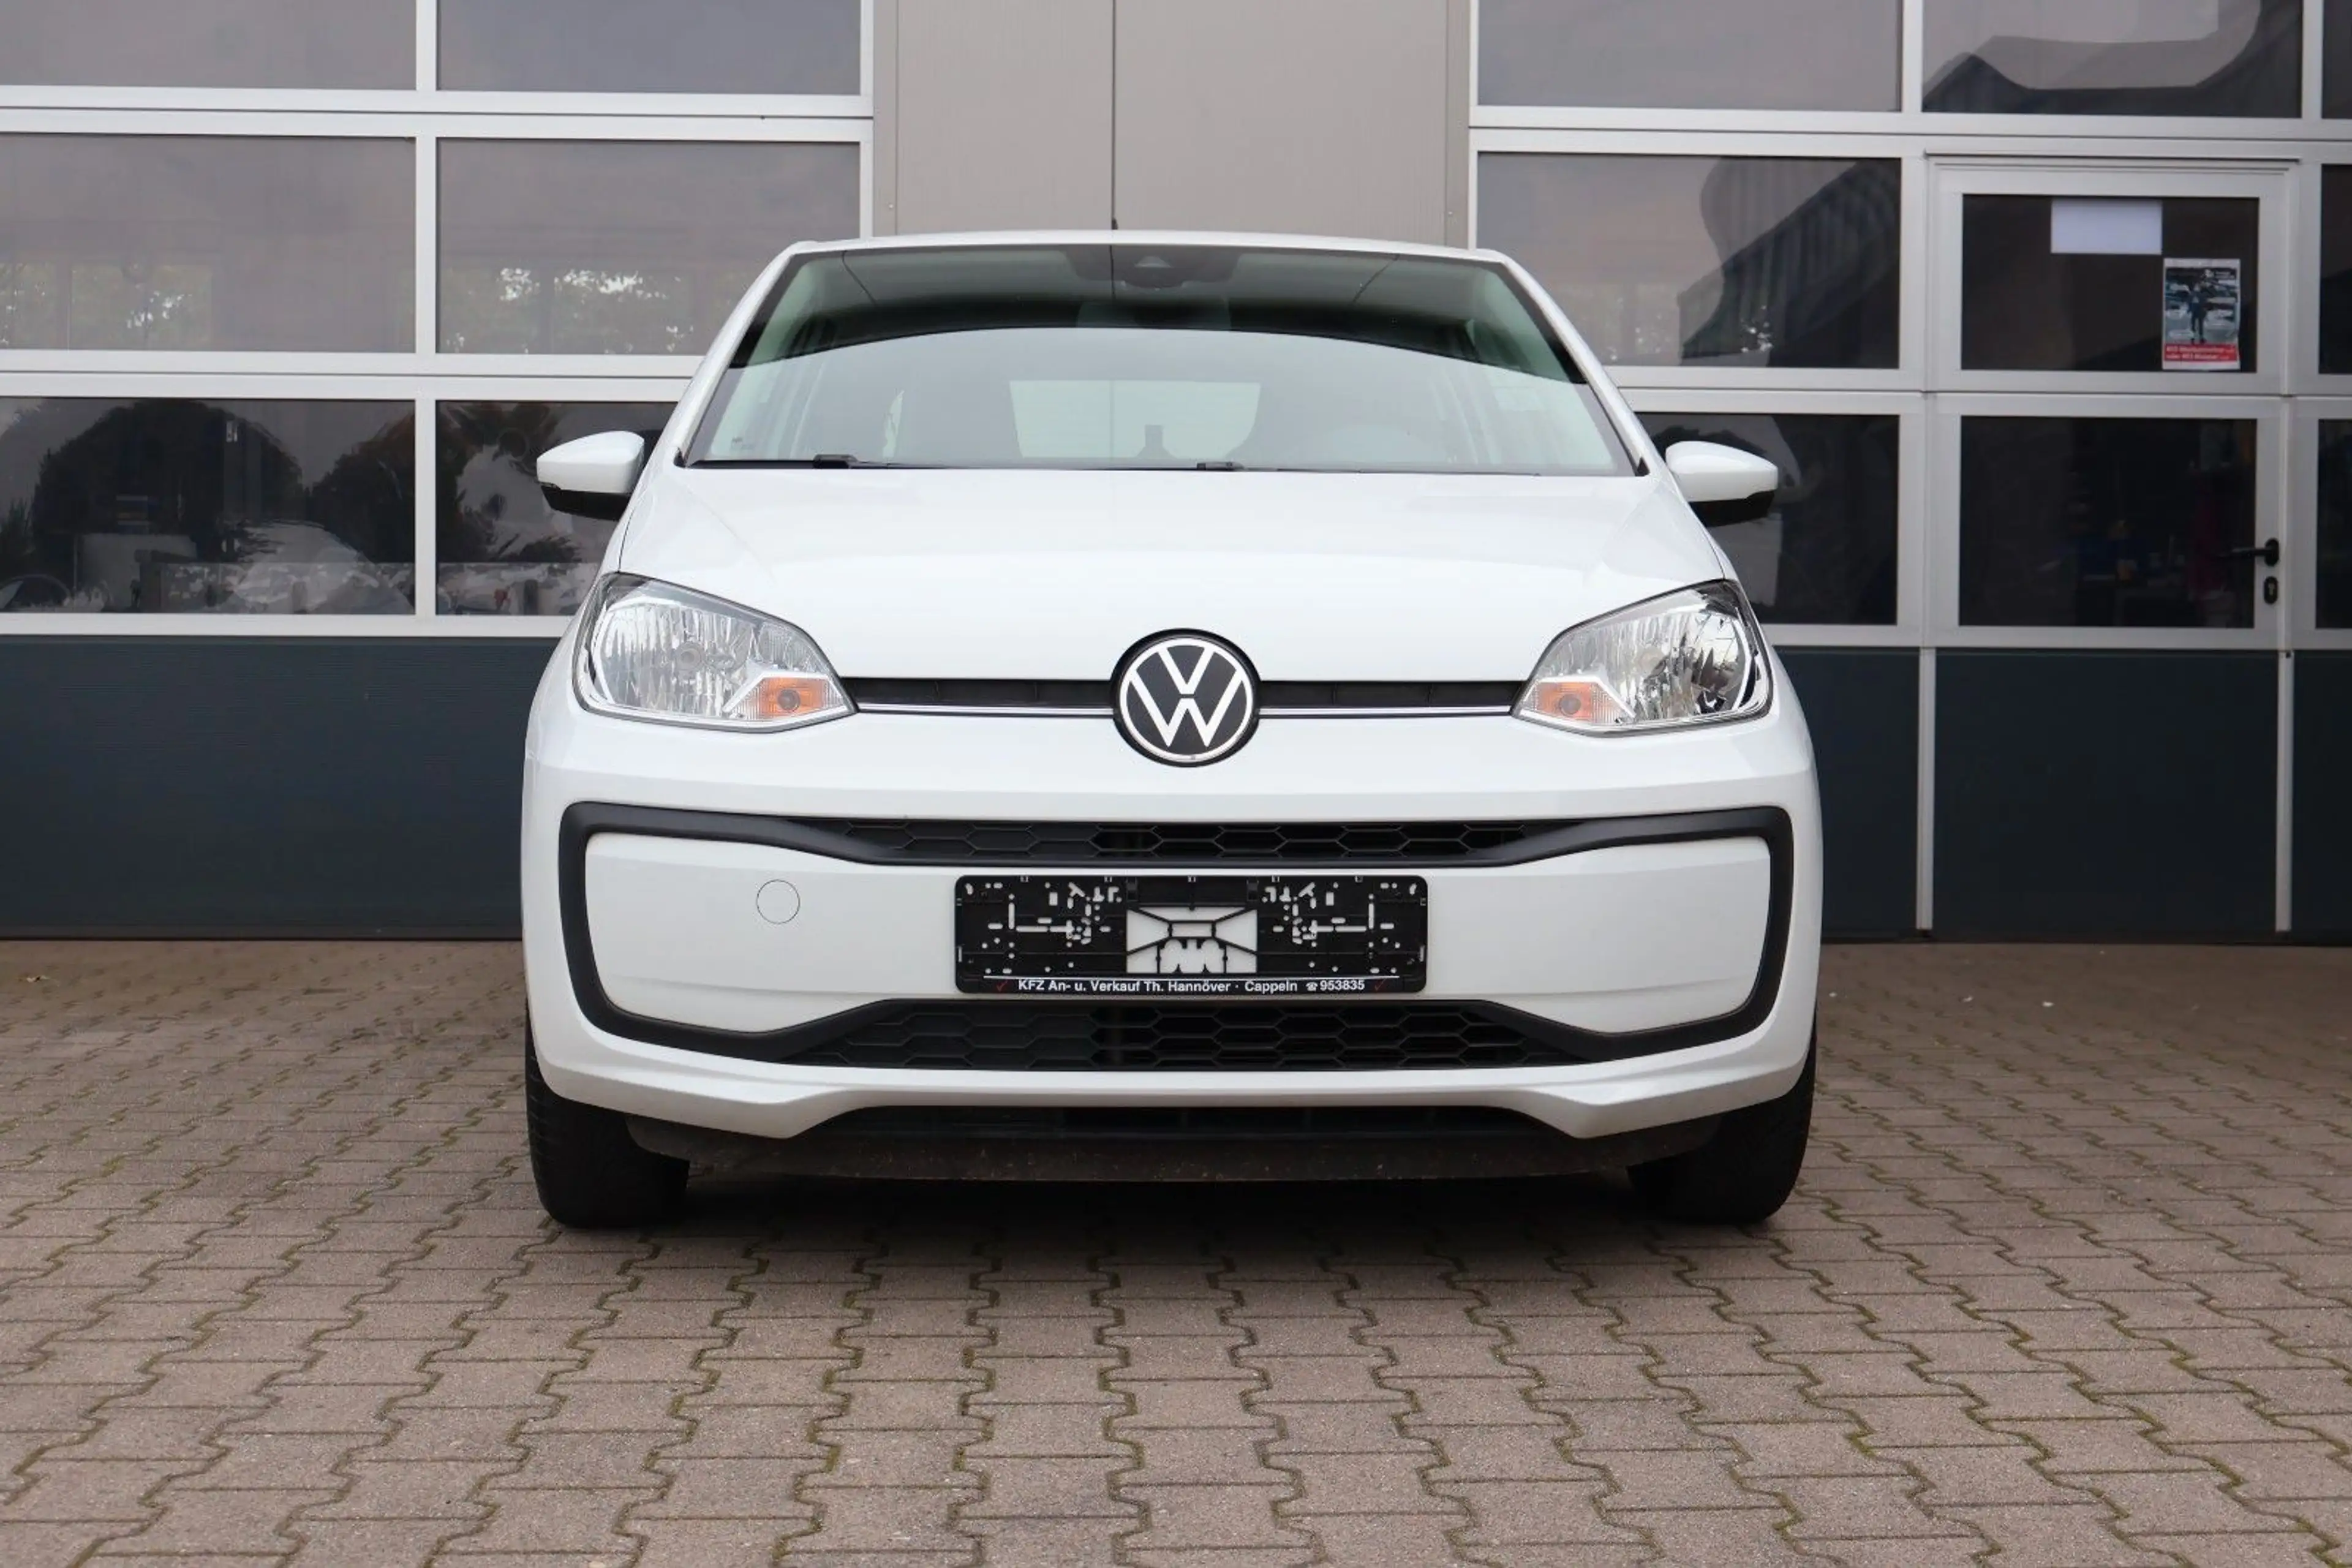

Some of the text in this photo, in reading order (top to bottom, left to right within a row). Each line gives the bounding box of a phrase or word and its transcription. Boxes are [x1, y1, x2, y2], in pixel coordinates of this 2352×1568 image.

[1127, 641, 1246, 748] VW
[1018, 979, 1045, 990] KFZ
[1048, 979, 1071, 992] An-
[1074, 982, 1087, 992] u.
[1090, 980, 1140, 992] Verkauf
[1143, 981, 1164, 992] Th.
[1245, 981, 1298, 994] Cappeln
[1319, 980, 1365, 991] 953835
